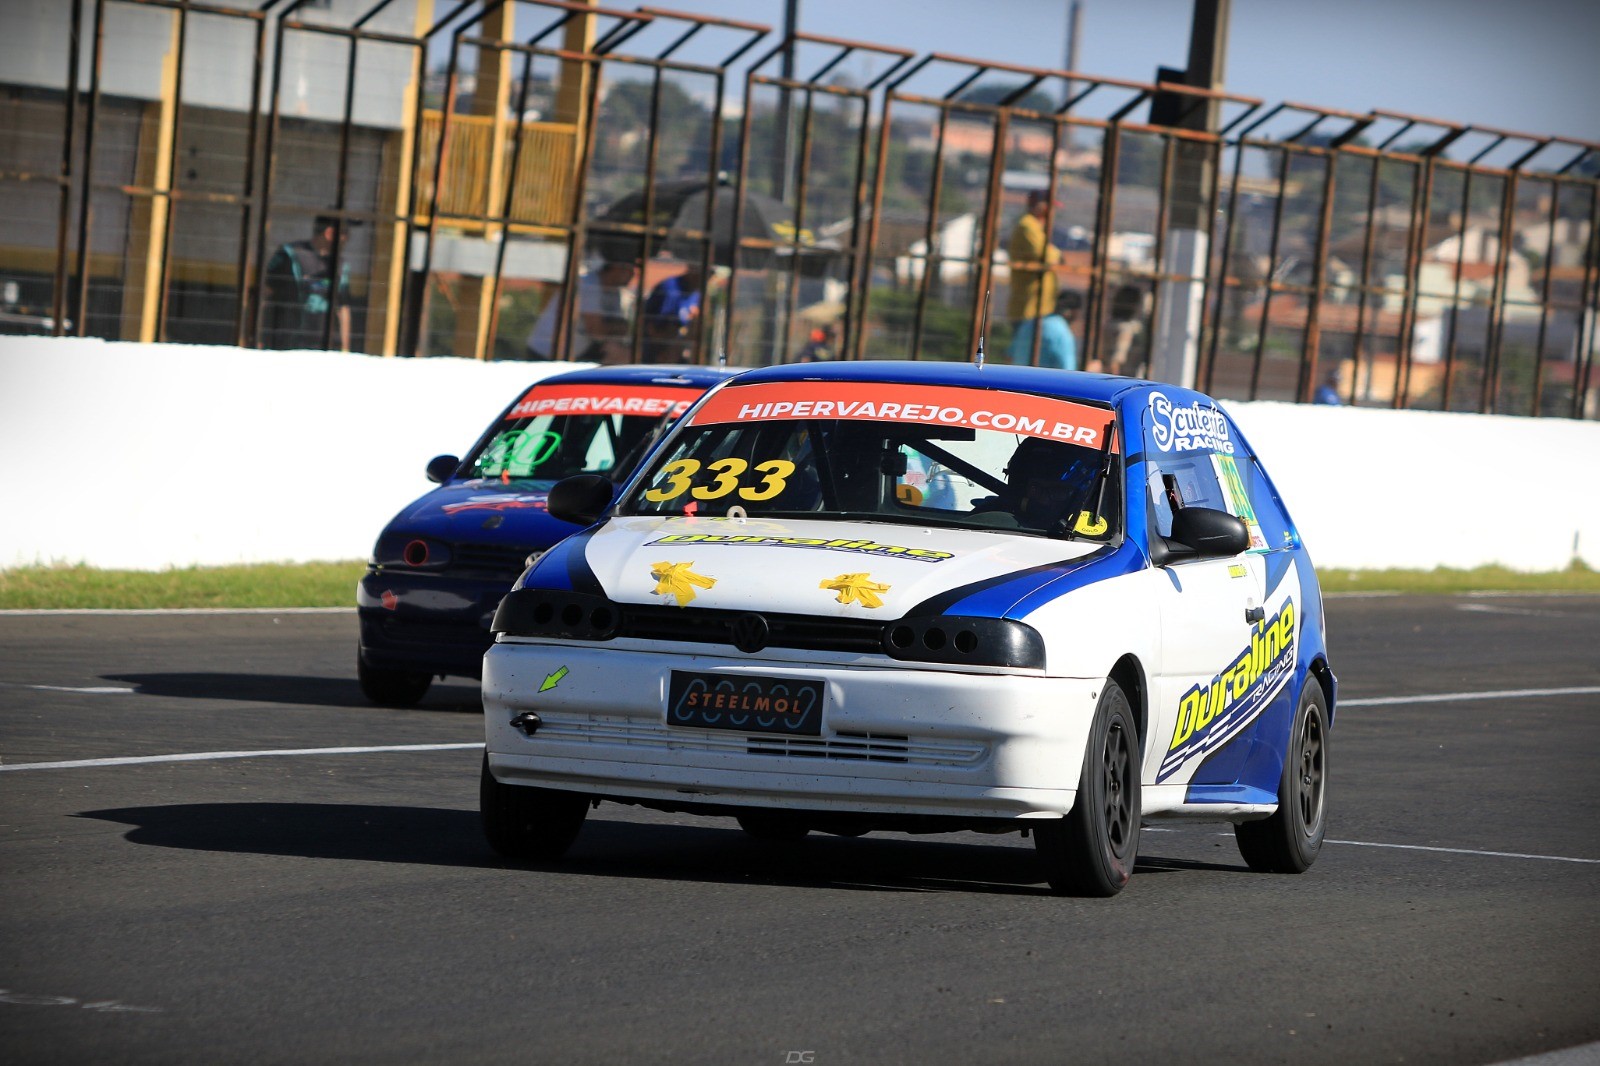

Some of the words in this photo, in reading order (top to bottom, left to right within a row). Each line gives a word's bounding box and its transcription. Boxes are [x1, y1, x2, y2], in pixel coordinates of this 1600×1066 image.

[737, 400, 1097, 444] HIPERVAREJO.COM.BR
[1174, 436, 1235, 454] RACING
[645, 457, 796, 502] 333
[1169, 601, 1295, 751] Duraline
[1251, 645, 1294, 703] RACING
[687, 692, 801, 714] STEELMOL
